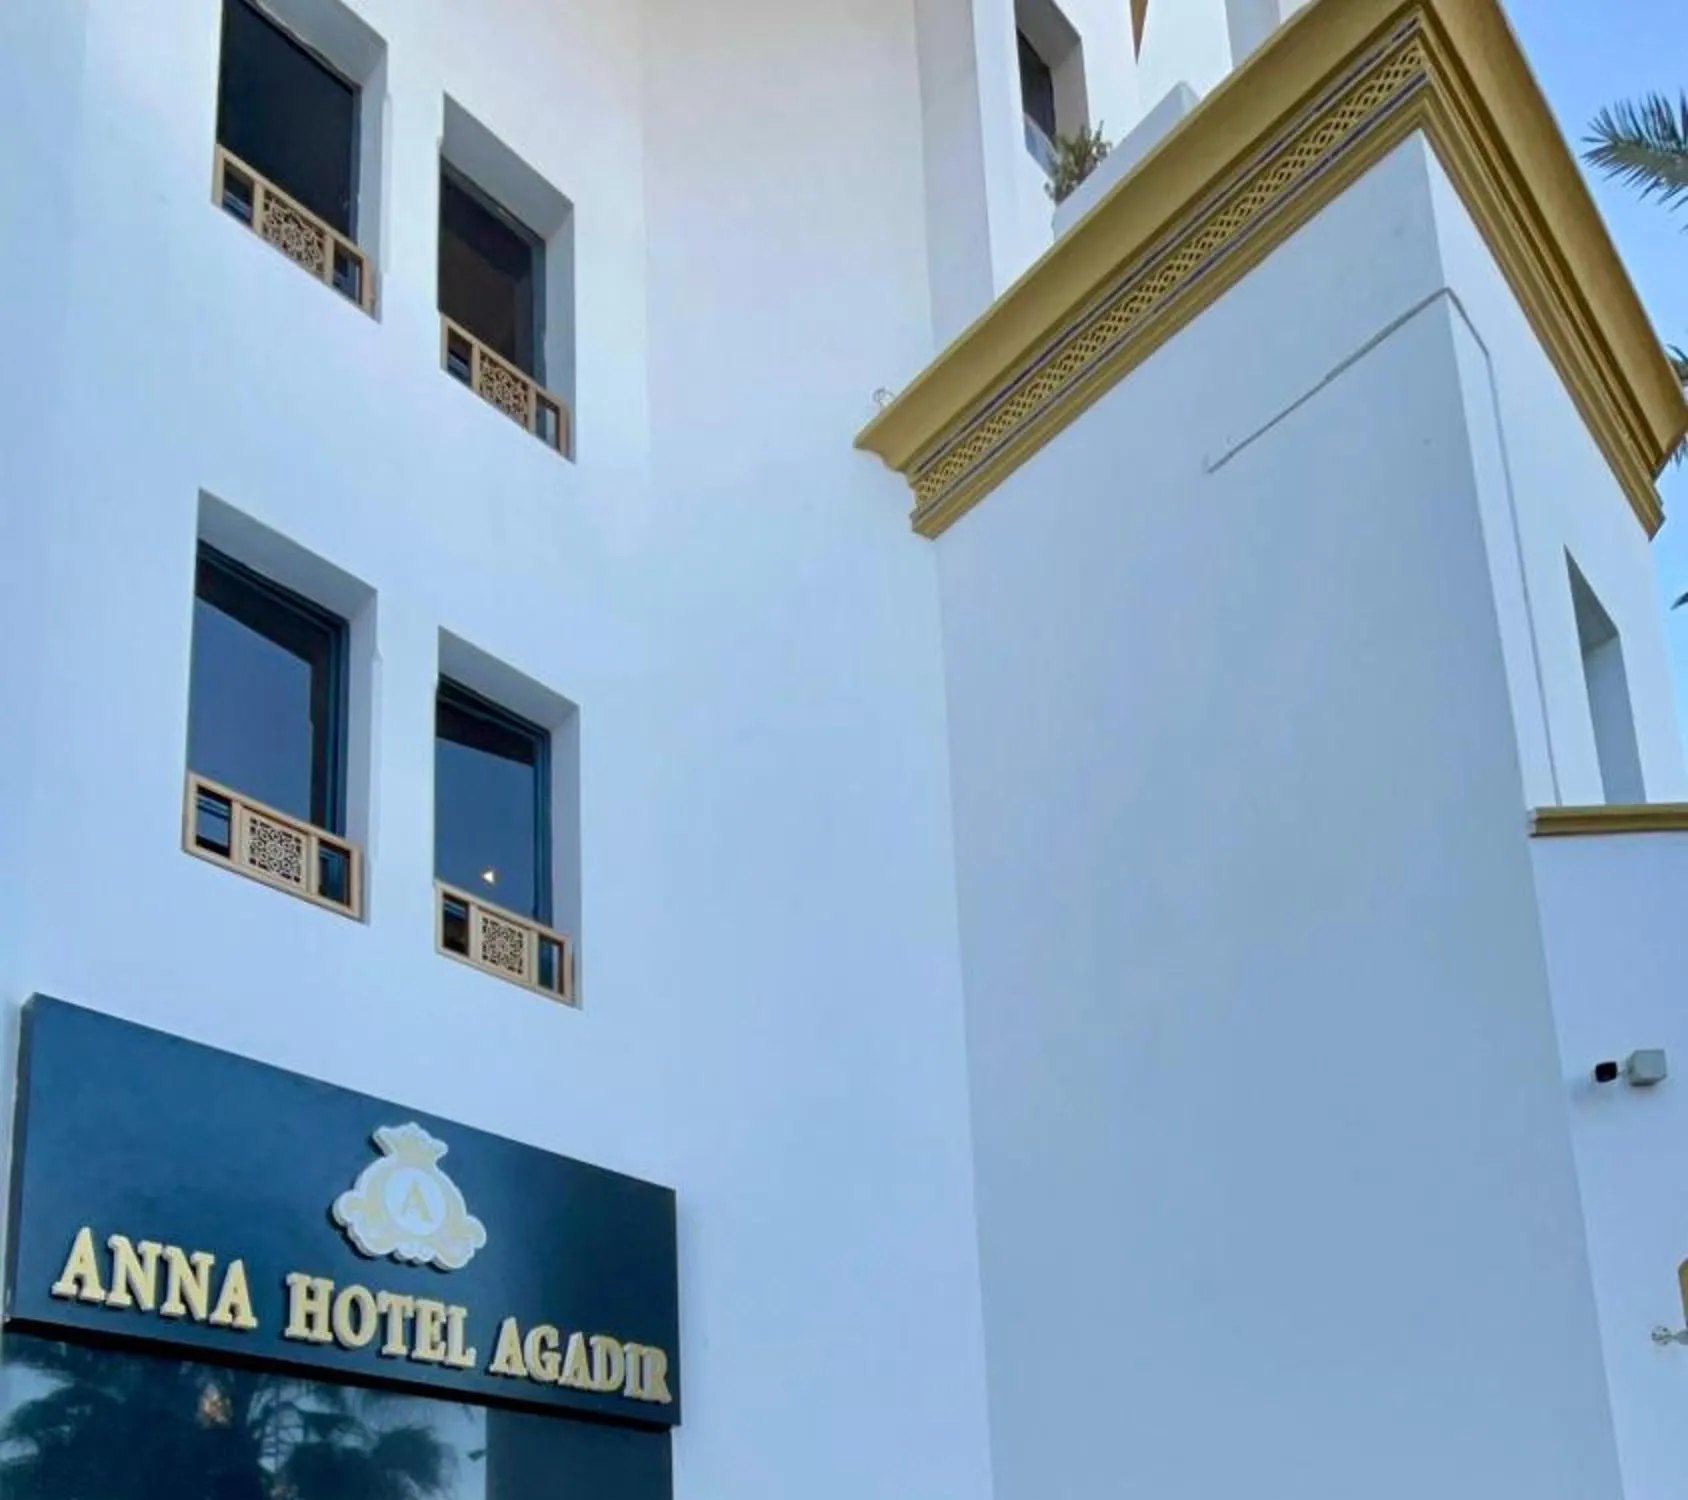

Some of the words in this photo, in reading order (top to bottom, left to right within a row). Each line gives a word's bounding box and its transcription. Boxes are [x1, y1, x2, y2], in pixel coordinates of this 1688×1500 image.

[401, 1181, 433, 1222] A
[52, 1227, 257, 1328] ANNA
[285, 1272, 477, 1368] HOTEL
[490, 1317, 672, 1405] AGADIR
